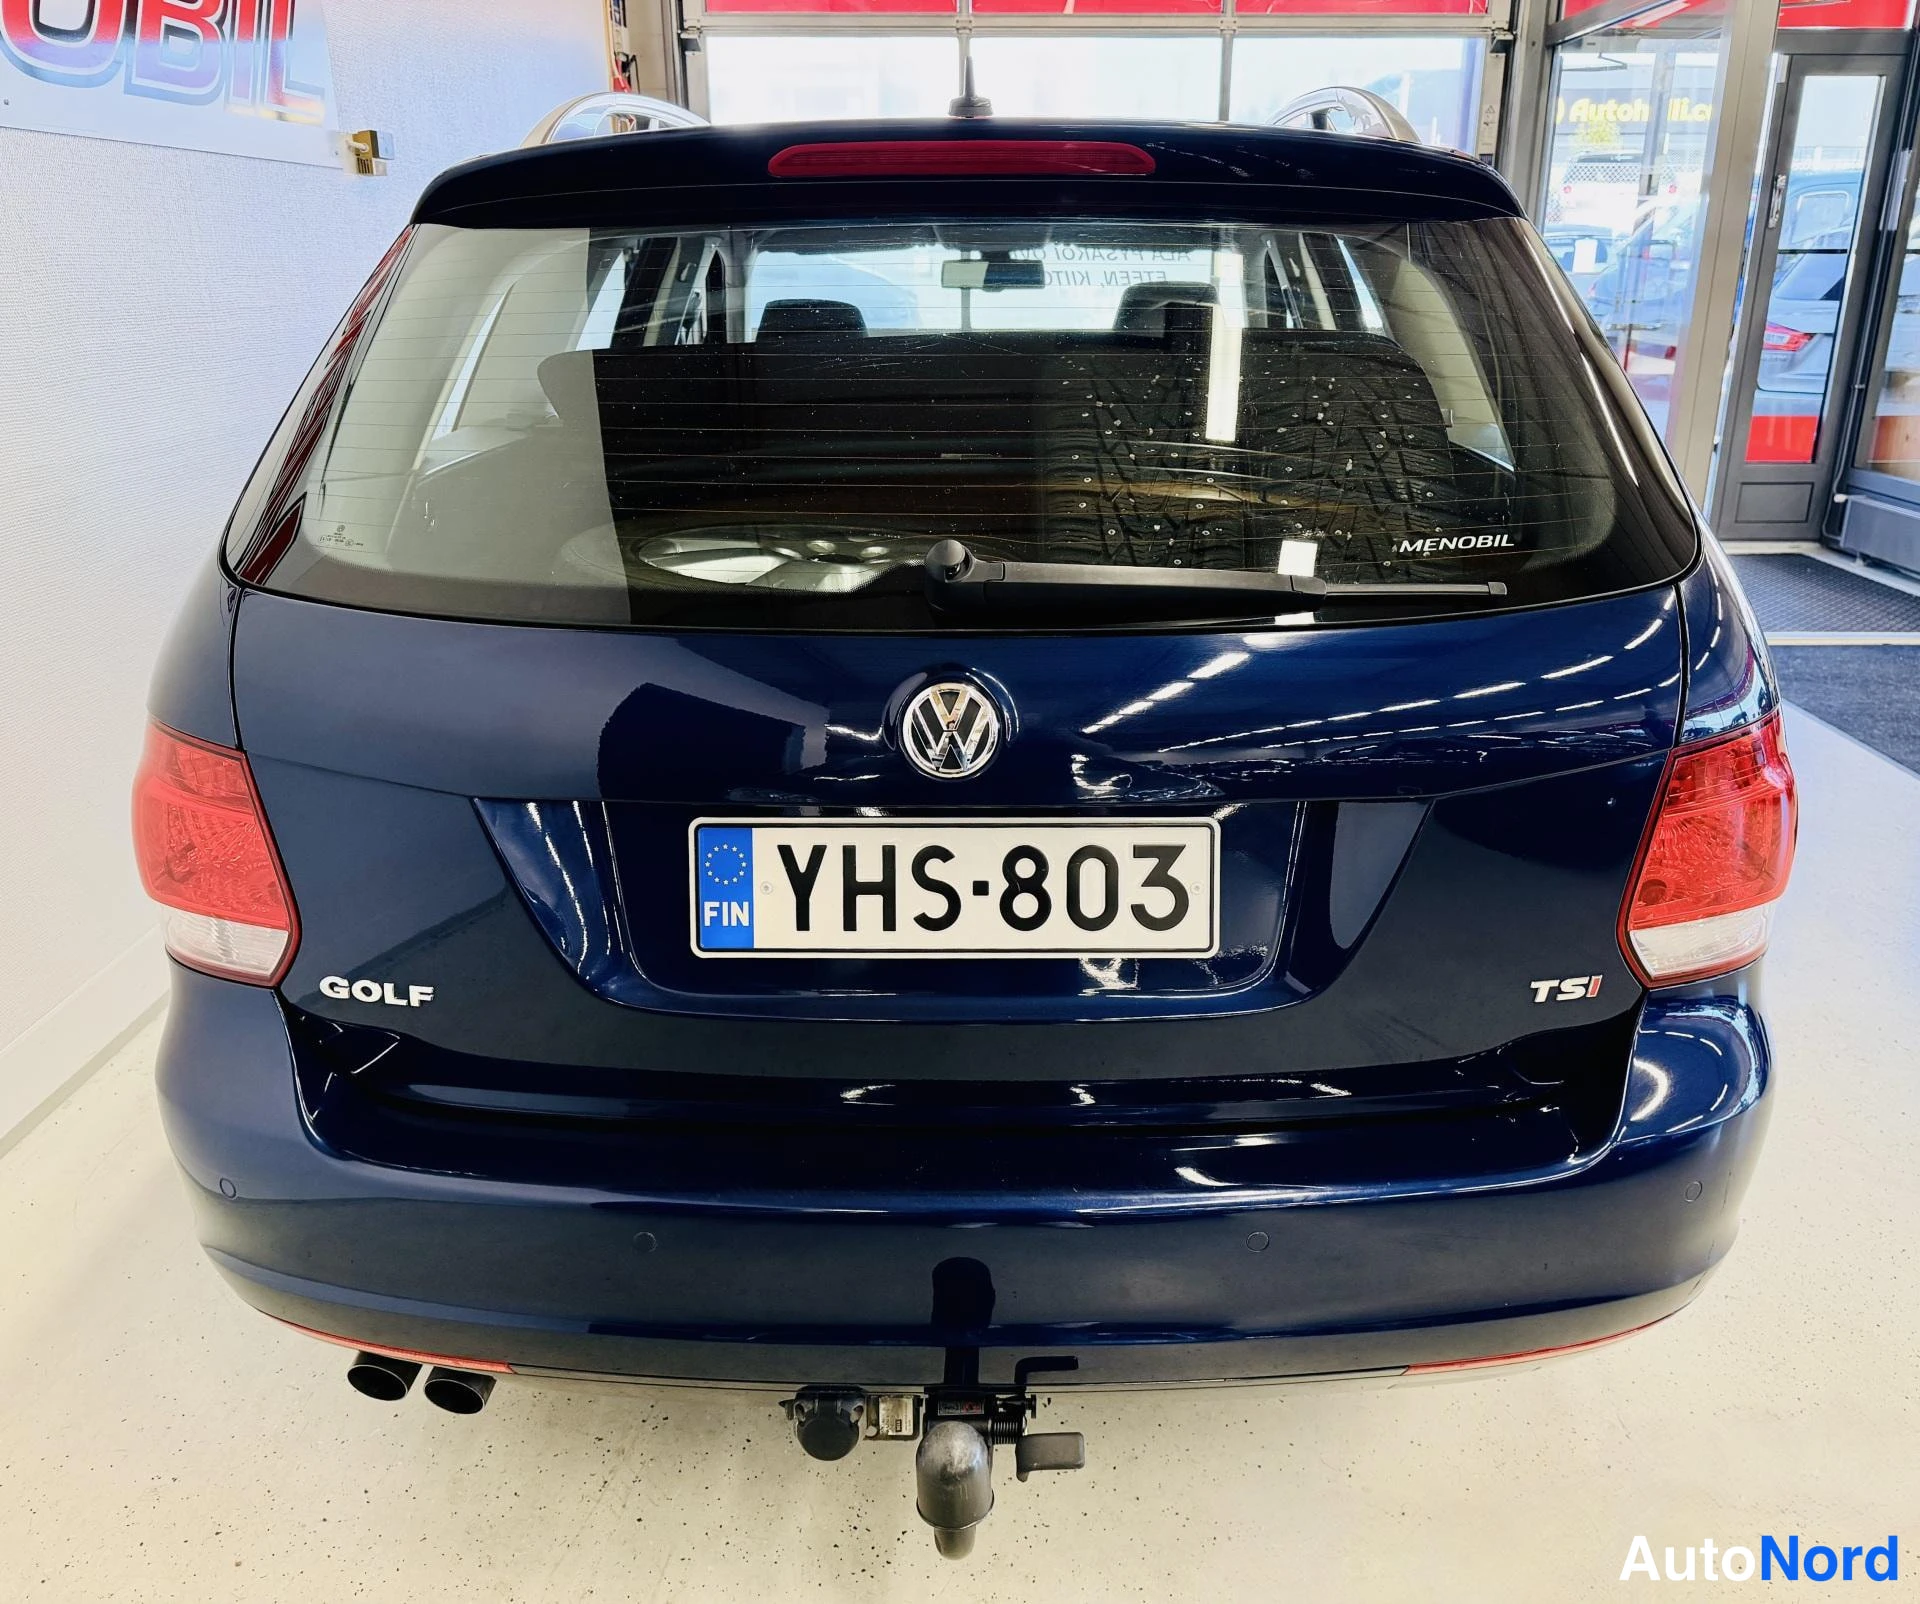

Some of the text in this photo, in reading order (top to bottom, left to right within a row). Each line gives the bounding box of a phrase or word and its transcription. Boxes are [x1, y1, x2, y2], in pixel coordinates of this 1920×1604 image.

[1399, 534, 1515, 553] MENOBIL
[777, 844, 1190, 932] YHS-803
[704, 901, 749, 927] FIN
[319, 975, 434, 1007] GOLF
[1530, 974, 1603, 1003] TSI
